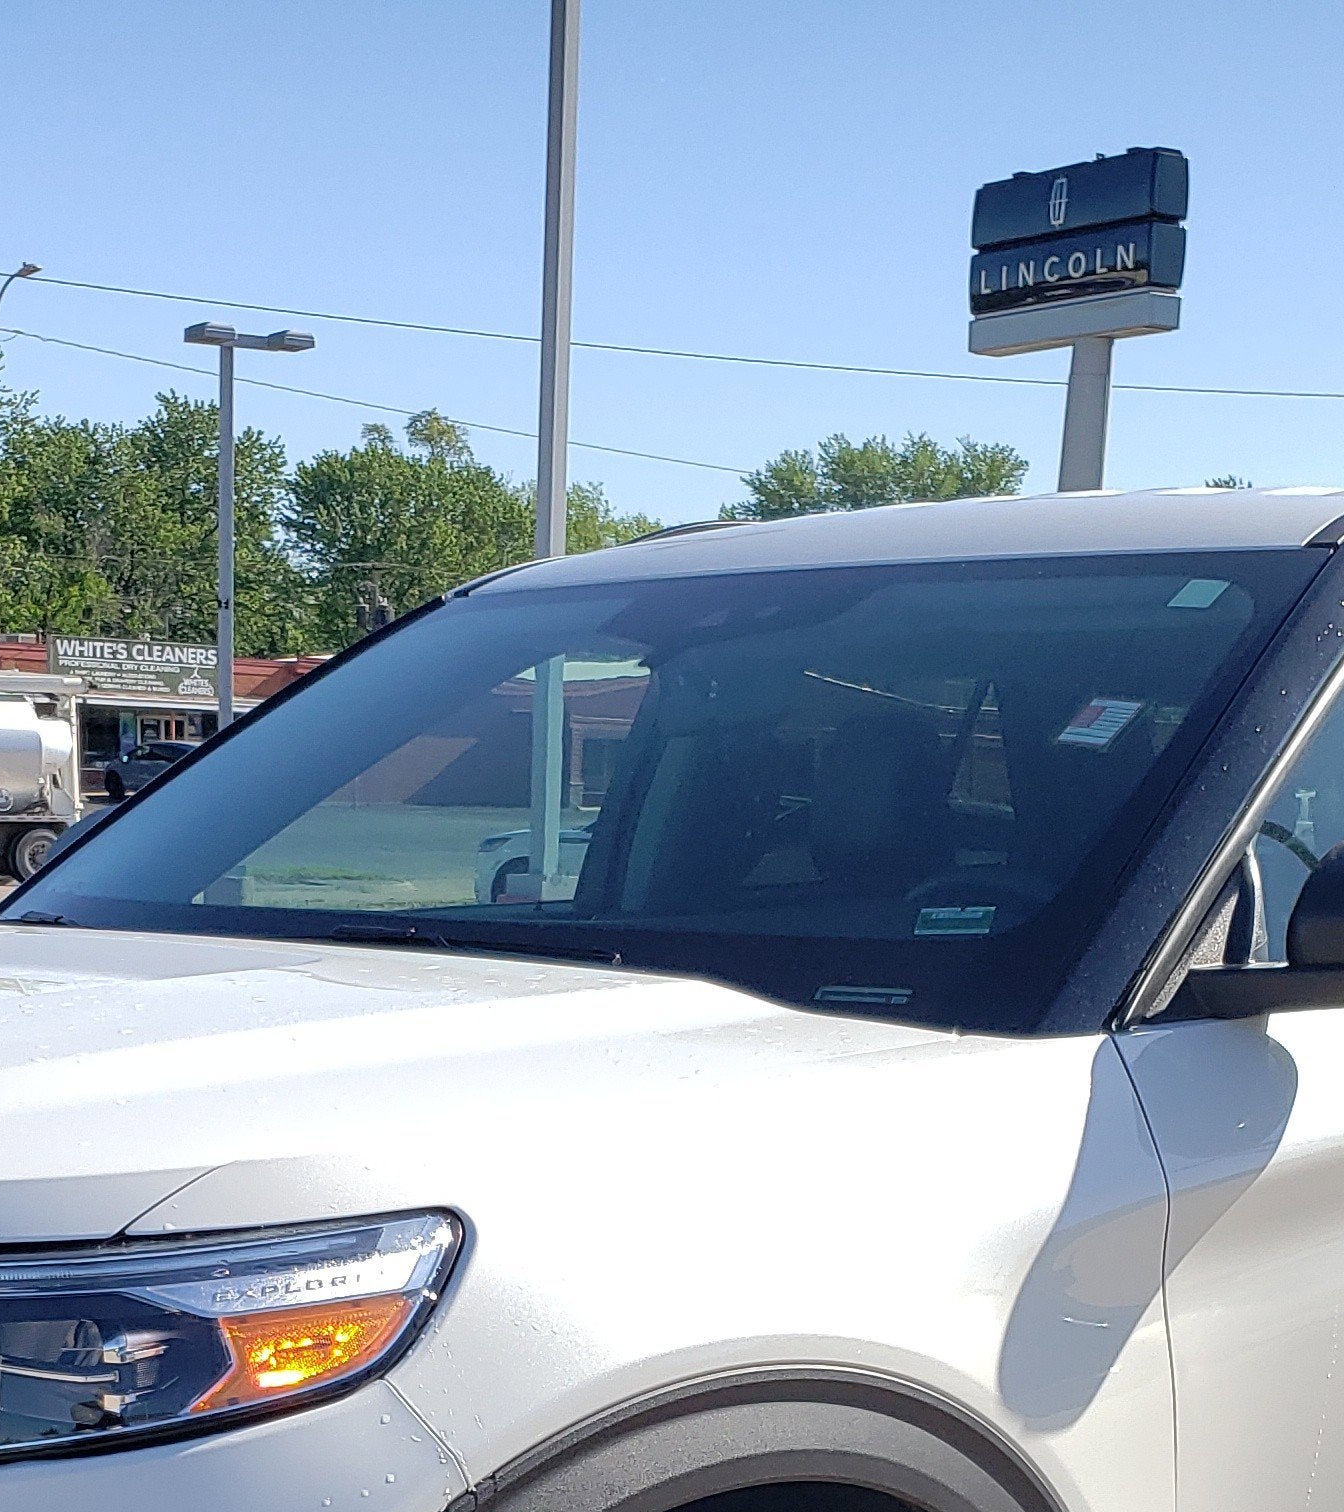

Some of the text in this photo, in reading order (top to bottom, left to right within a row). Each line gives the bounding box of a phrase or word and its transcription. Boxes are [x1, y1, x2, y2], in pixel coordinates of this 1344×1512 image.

[980, 241, 1136, 295] LINCOLN
[56, 639, 218, 666] WHITE'S CLEANERS
[122, 663, 138, 671] DRY
